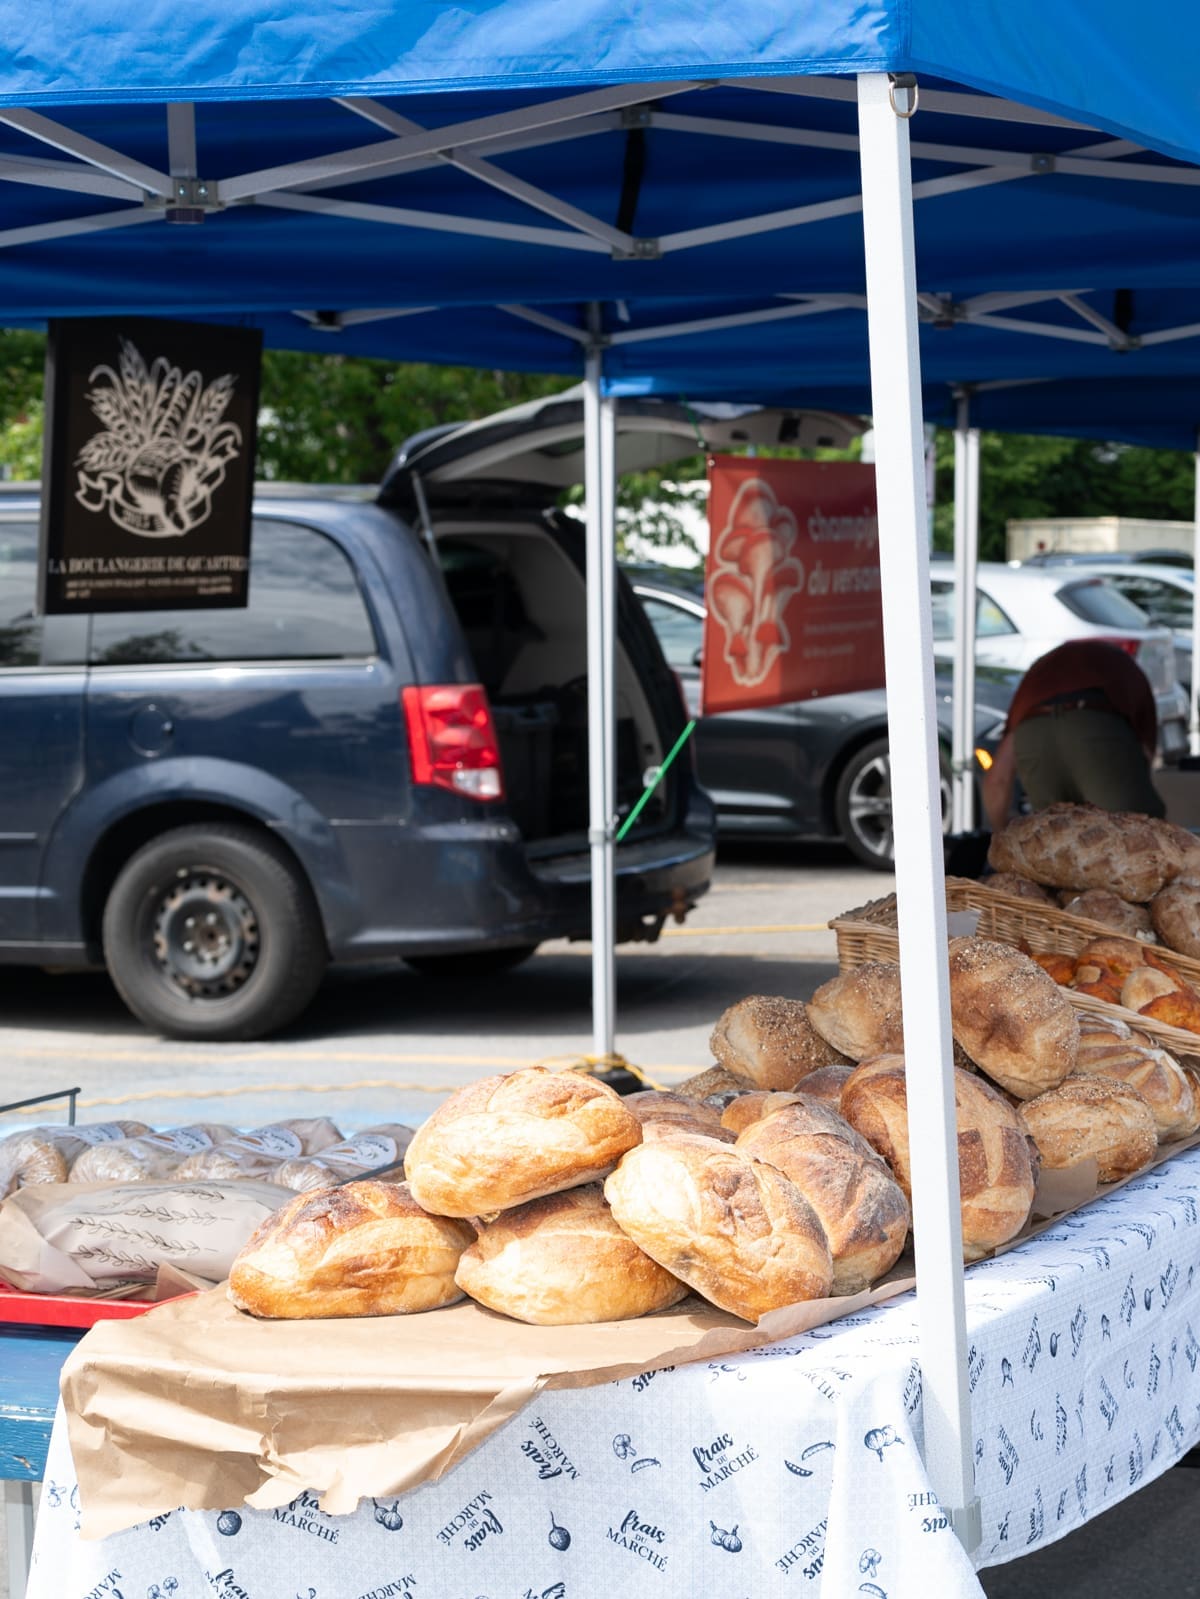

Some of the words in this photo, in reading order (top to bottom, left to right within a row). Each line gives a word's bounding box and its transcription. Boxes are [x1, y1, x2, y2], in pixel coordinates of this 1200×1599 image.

[521, 1440, 562, 1479] frais
[528, 1416, 581, 1480] MARCHÉ
[692, 1433, 734, 1474] frais
[716, 1454, 729, 1467] DU
[698, 1444, 760, 1493] MARCHÉ
[272, 1508, 340, 1545] MARCHÉ
[304, 1510, 318, 1519] DU
[436, 1489, 493, 1546] MARCHÉ
[464, 1508, 503, 1551] frais
[620, 1509, 666, 1544] frais
[606, 1527, 669, 1573] MARCHÉ
[635, 1533, 649, 1543] DU
